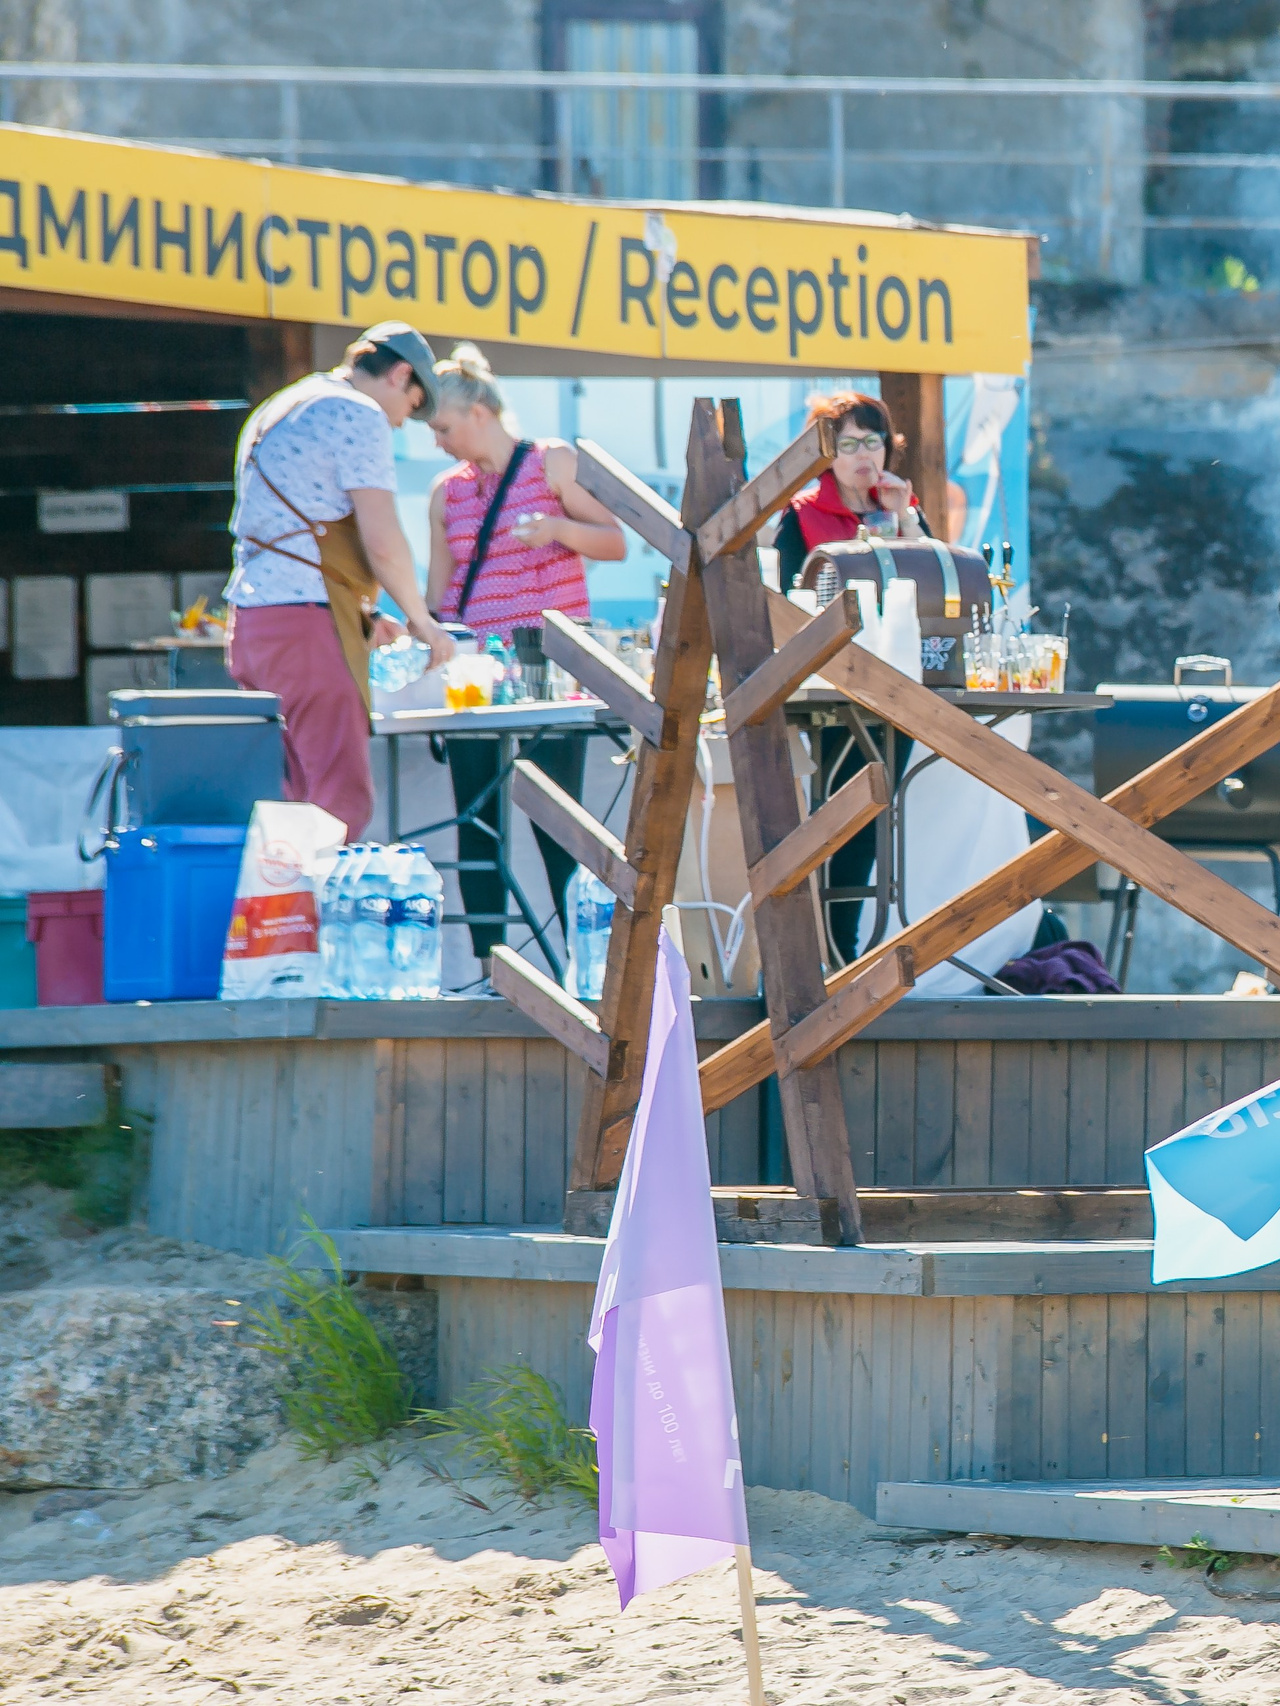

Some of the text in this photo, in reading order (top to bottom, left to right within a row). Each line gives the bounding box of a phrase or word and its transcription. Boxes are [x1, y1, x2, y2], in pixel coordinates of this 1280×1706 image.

[0, 178, 547, 336] дминистратор
[619, 235, 955, 358] Reception
[645, 1381, 665, 1401] до
[657, 1403, 680, 1434] 100
[668, 1438, 688, 1464] лет
